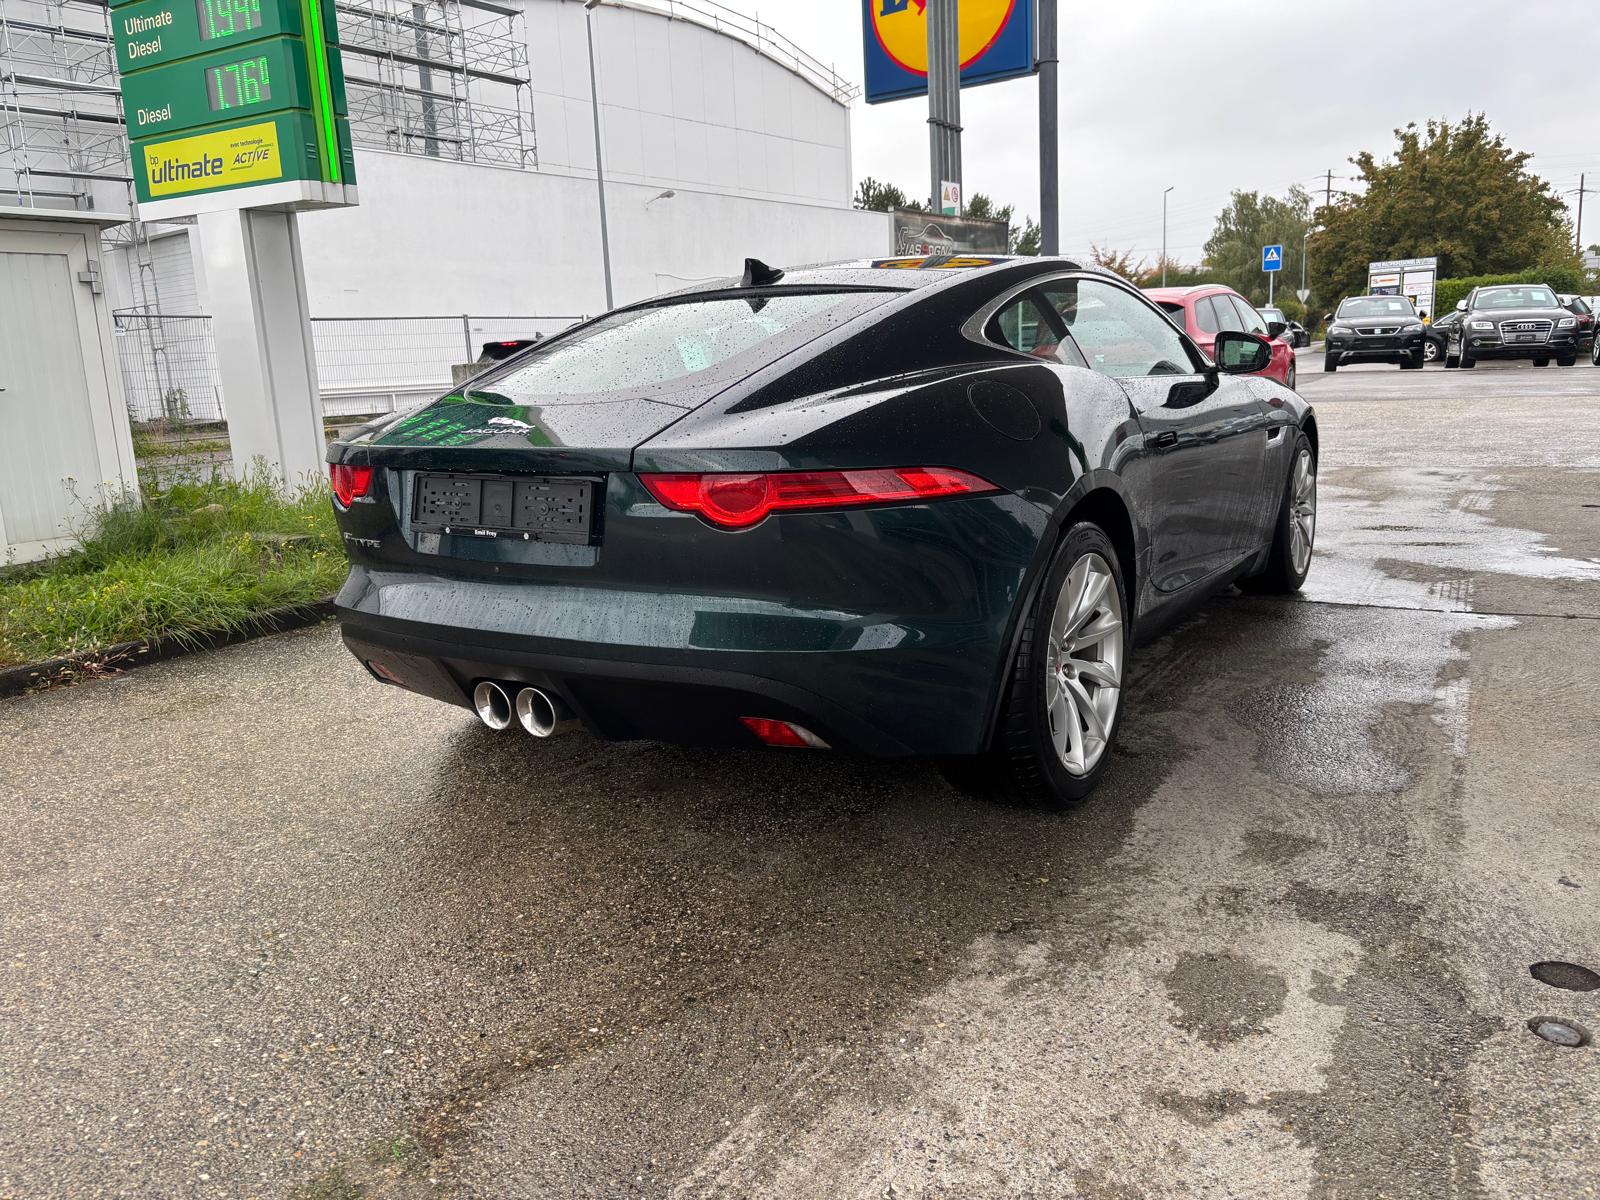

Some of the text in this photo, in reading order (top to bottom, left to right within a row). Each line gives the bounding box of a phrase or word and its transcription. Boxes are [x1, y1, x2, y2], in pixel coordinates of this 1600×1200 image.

[124, 11, 173, 36] Ultimate
[128, 35, 162, 59] Diesel
[137, 104, 172, 126] Diesel
[150, 154, 159, 167] bp
[233, 149, 270, 165] ACTIVE
[152, 153, 223, 184] ultimate
[462, 428, 530, 436] JAGUAR
